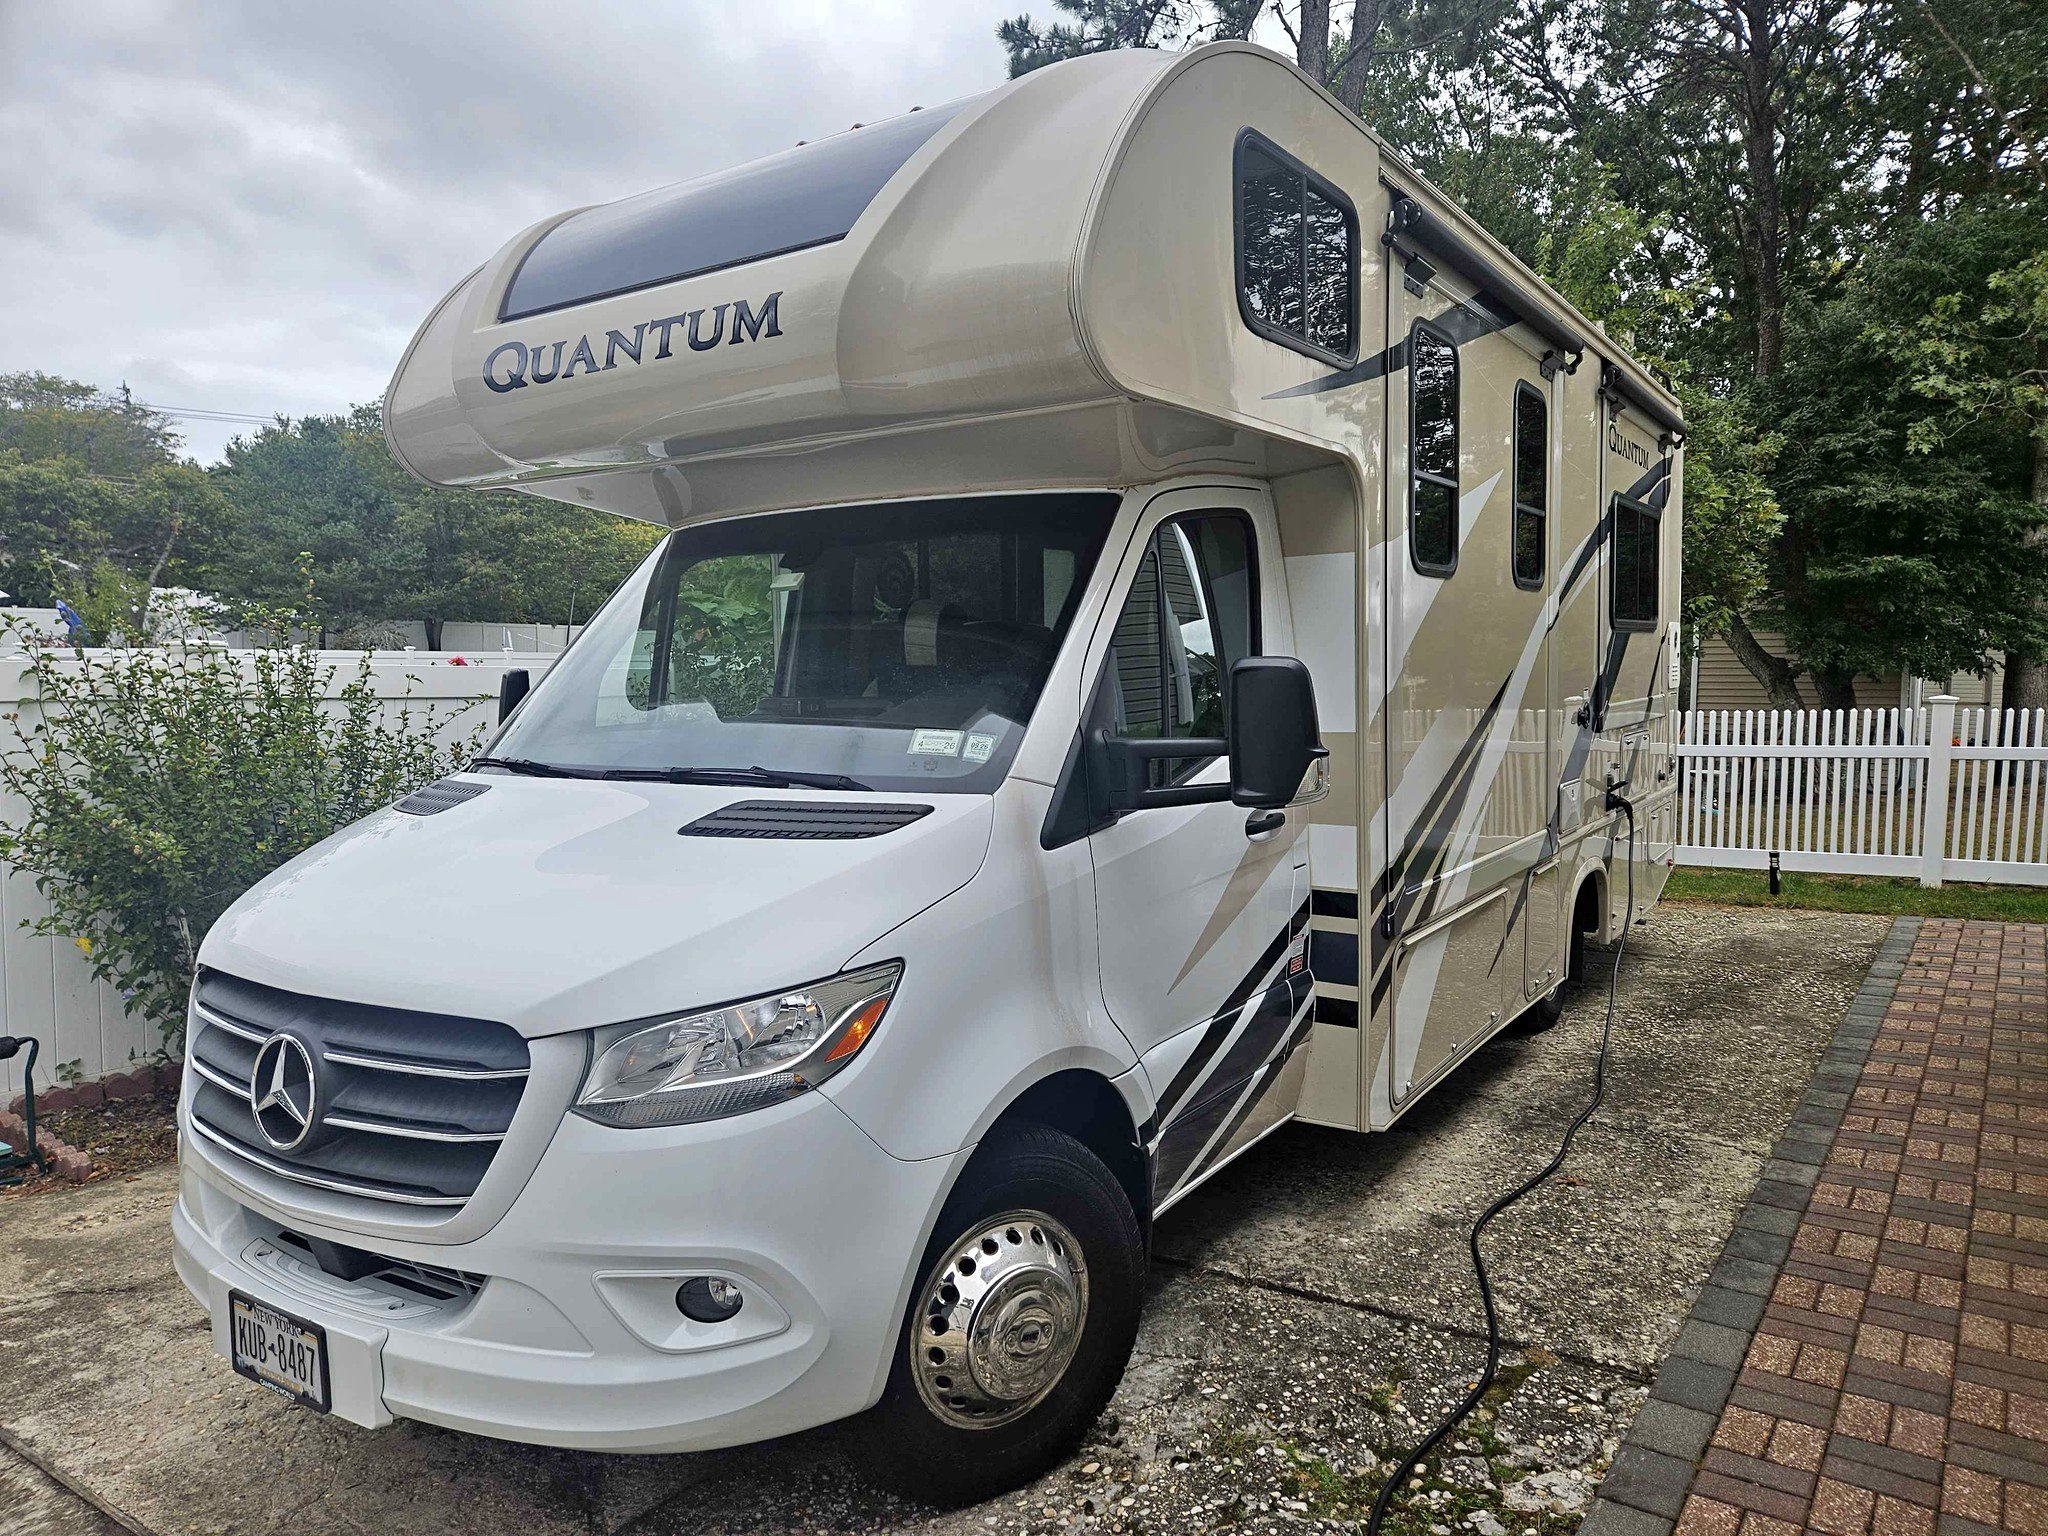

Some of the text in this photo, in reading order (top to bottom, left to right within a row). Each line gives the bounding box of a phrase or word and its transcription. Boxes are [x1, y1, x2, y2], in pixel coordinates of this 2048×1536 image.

[483, 291, 784, 393] QUANTUM
[1609, 424, 1649, 470] QUANTUM
[943, 742, 956, 750] 26
[253, 1308, 299, 1338] NEW YORK
[239, 1316, 267, 1363] KUB
[278, 1333, 315, 1387] 8487
[278, 1388, 296, 1400] WORLD
